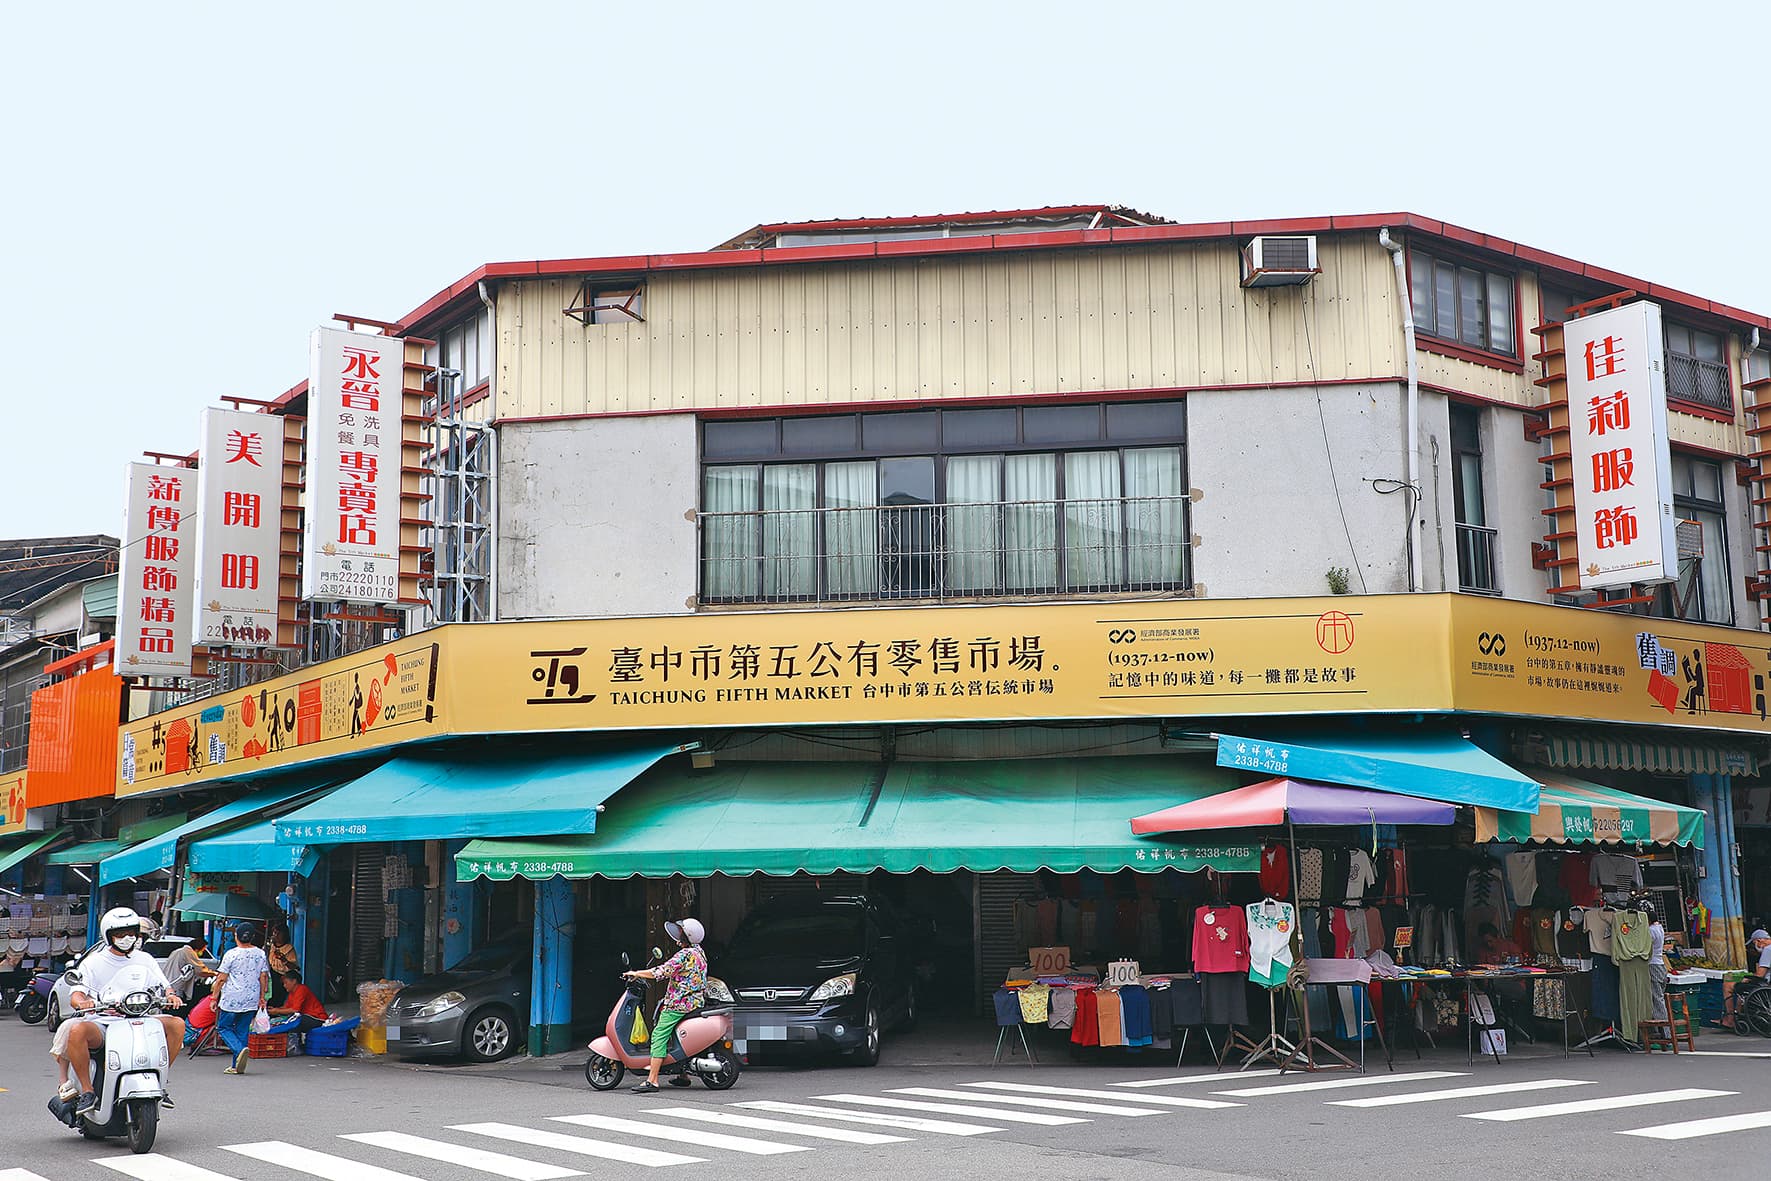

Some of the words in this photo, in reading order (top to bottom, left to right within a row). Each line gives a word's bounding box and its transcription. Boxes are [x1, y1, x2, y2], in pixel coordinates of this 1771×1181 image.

[1584, 335, 1638, 550] 佳莉服飾
[337, 450, 379, 546] 專賣店
[221, 429, 263, 591] 美開明
[138, 474, 183, 654] 薪傳服飾精品
[341, 559, 375, 574] 電話
[1524, 629, 1601, 656] (1937.12-now)
[1108, 647, 1215, 667] (1937.12-now)
[610, 688, 707, 706] TAICHUNG
[716, 687, 768, 703] FIFTH
[775, 685, 853, 700] MARKET
[1234, 754, 1288, 773] 2338-4788
[326, 824, 368, 835] 2338-4788
[524, 862, 574, 873] 2338-4788
[1034, 952, 1067, 972] 100
[1112, 965, 1137, 983] 100
